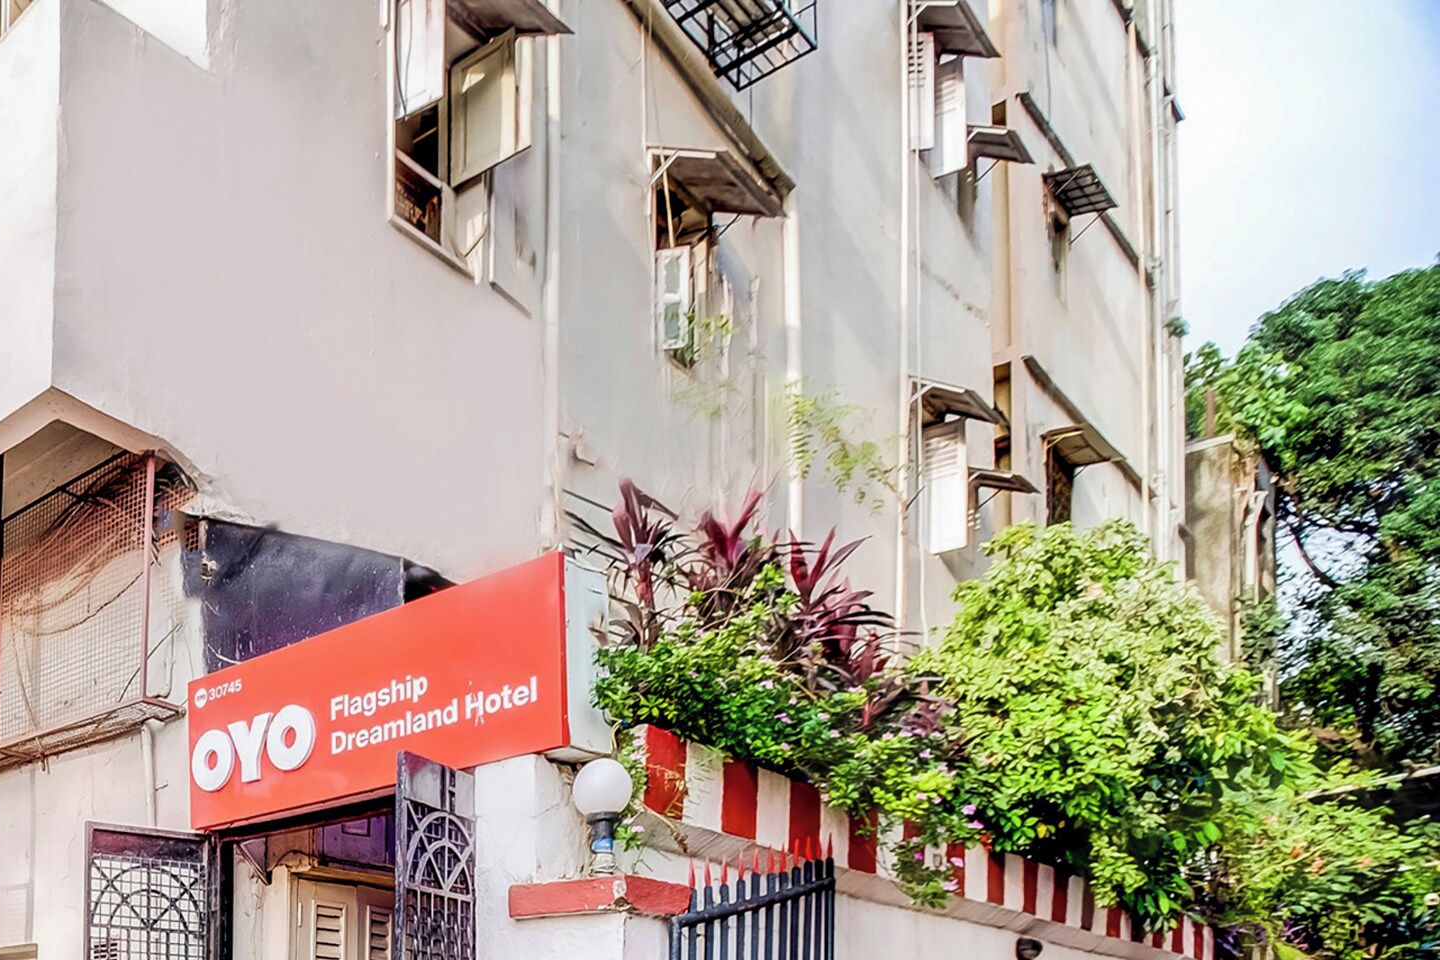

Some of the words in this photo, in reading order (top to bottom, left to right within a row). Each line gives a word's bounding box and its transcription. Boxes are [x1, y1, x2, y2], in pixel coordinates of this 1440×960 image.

[208, 678, 243, 701] 30745
[330, 675, 428, 721] Flagship
[330, 698, 459, 755] Dreamland
[464, 676, 538, 720] Hotel
[191, 704, 316, 792] OYO
